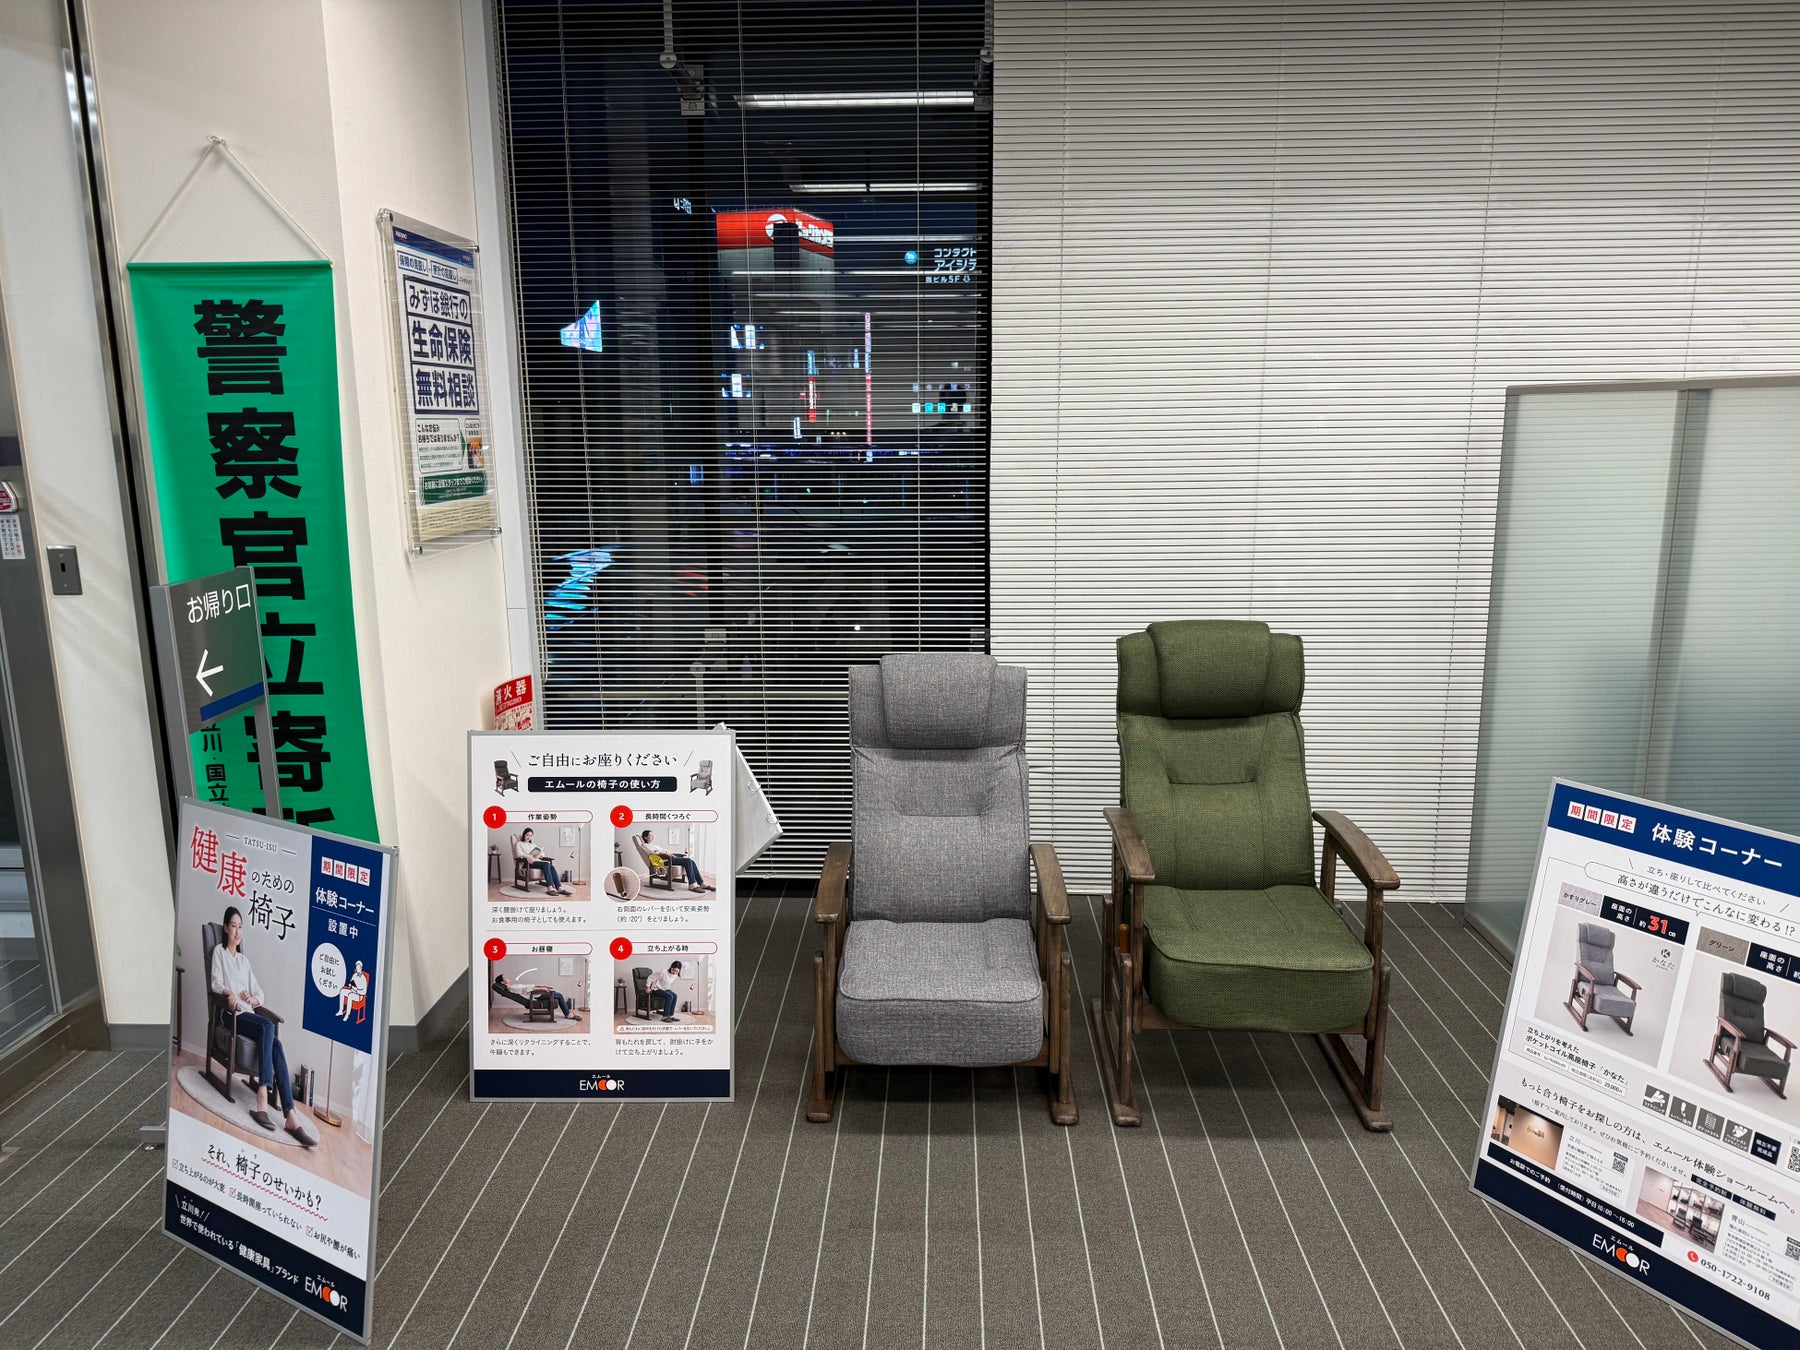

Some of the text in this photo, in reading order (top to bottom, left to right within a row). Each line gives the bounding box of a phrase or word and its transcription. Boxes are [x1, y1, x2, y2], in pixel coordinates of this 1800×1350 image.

[409, 285, 468, 320] みずほ銀行の
[411, 320, 473, 364] 生命保険
[416, 368, 476, 408] 無料相談
[186, 583, 252, 624] お帰り口
[527, 753, 678, 768] ご自由にお座りください
[544, 779, 661, 790] エムールの椅子の使い方
[492, 812, 498, 821] 1
[527, 813, 558, 821] 作業姿勢
[618, 812, 625, 821] 2
[645, 812, 691, 821] 長時間くつろぐ
[1568, 803, 1636, 832] 期間限定
[243, 837, 278, 853] TATSU-ISU
[1651, 822, 1784, 869] 体験コーナー
[322, 857, 371, 886] 期間限定
[1646, 865, 1766, 906] 立ち・座りして比べてください
[315, 886, 375, 915] 体験コーナー
[1562, 892, 1598, 906] かすりグレー
[248, 889, 297, 942] 椅子
[1616, 913, 1631, 923] 高さ
[327, 918, 359, 940] 設置中
[492, 944, 499, 954] 3
[531, 944, 554, 953] お昼寝
[617, 944, 625, 954] 4
[646, 944, 689, 953] 立ち上がる時
[1708, 939, 1736, 952] グリーン
[319, 953, 340, 967] ご自由に
[1766, 962, 1783, 973] 高さ
[320, 966, 337, 978] お試し
[318, 977, 339, 990] ください
[1527, 1026, 1580, 1054] 立ち上がりを考えた
[178, 1161, 226, 1195] 立ち上がるのが大変
[1509, 1157, 1551, 1184] お電話でのご予約
[235, 1191, 303, 1231] 長時間座っていられない
[313, 1230, 361, 1260] お尻や腰が痛い
[1700, 1259, 1771, 1301] 050-1722-9108
